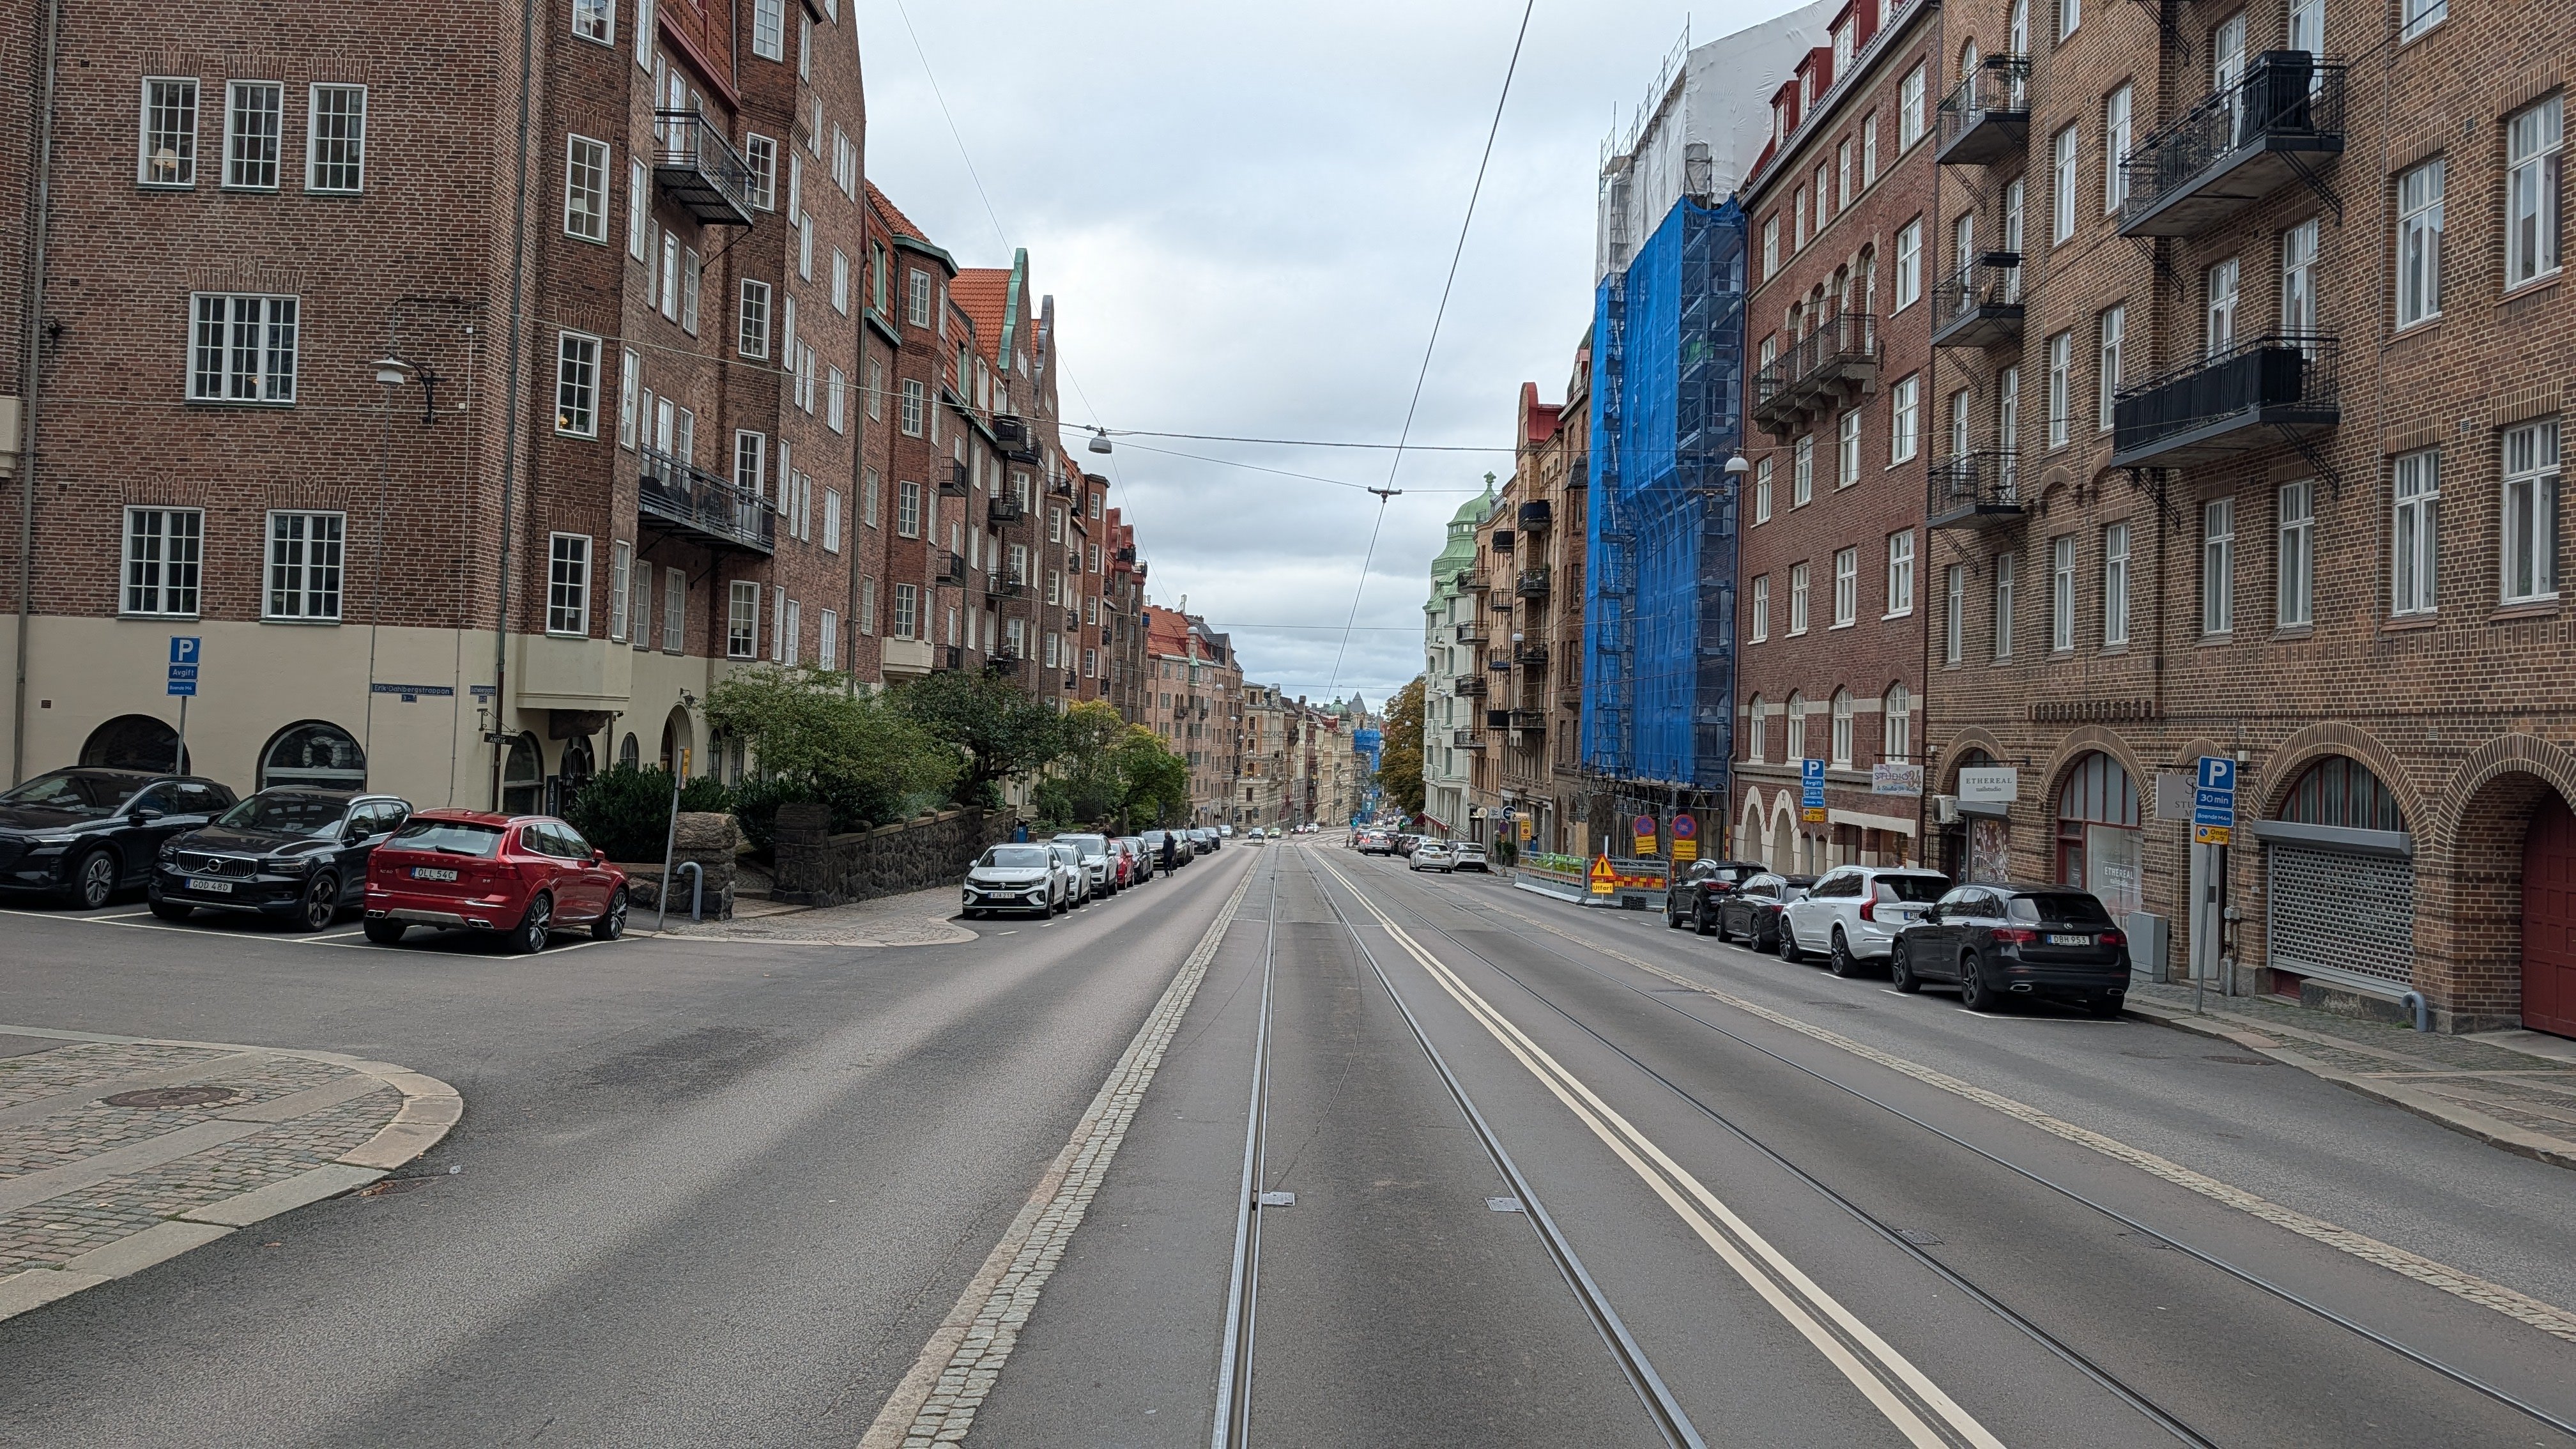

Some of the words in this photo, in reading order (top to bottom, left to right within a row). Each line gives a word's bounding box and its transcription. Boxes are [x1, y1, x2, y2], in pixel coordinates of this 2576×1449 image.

[178, 639, 194, 661] P
[172, 669, 194, 677] Avgift
[1808, 761, 1820, 776] P
[2208, 760, 2227, 786] P
[1874, 771, 1909, 781] STUDIO
[1908, 770, 1922, 788] 34
[2200, 793, 2213, 803] 30
[2214, 795, 2229, 804] min
[418, 868, 434, 878] OLL
[436, 870, 454, 879] 54C
[2104, 866, 2134, 880] ETHEREAL
[193, 880, 210, 889] GOD
[211, 882, 229, 891] 48D
